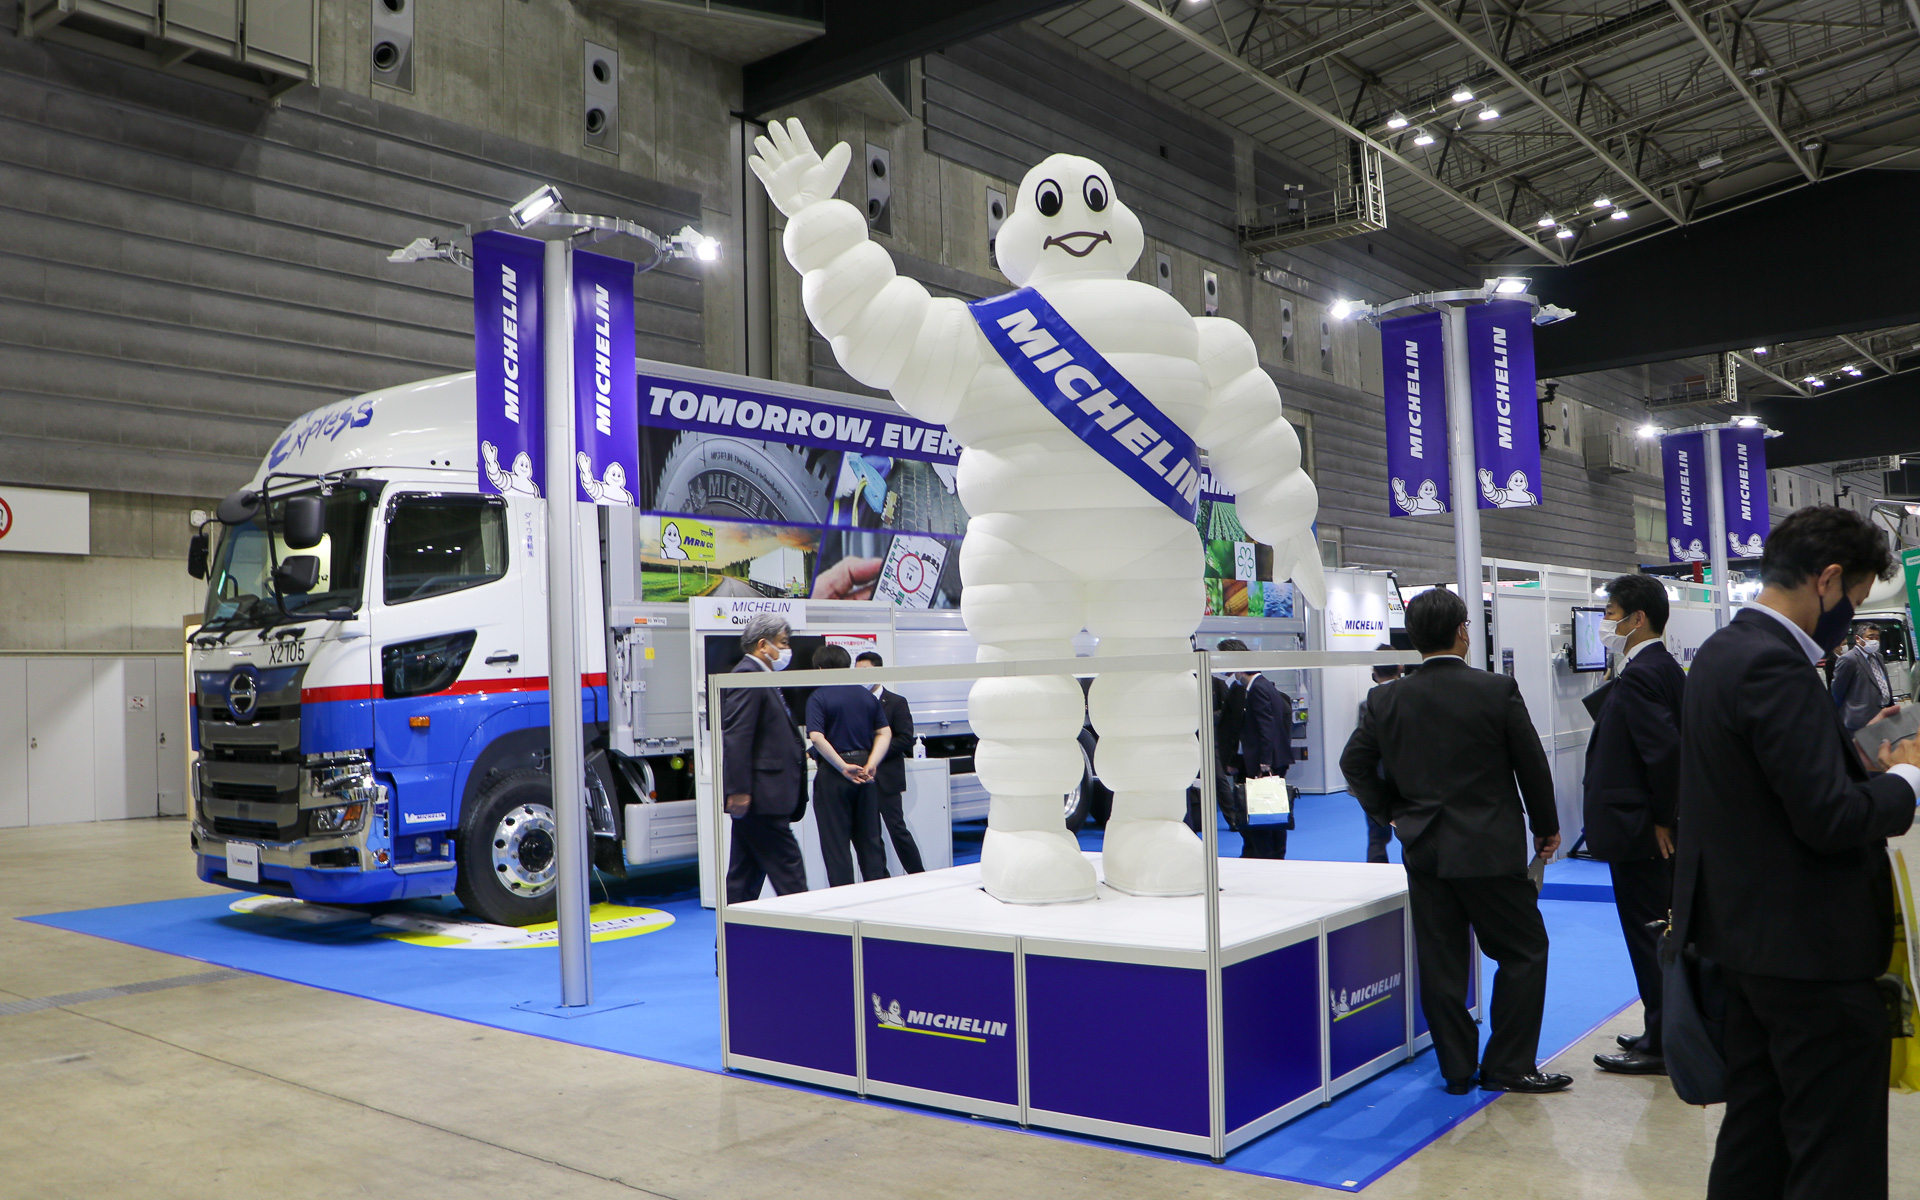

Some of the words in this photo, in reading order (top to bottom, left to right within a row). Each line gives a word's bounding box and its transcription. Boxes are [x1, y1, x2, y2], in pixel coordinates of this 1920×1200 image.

[501, 263, 520, 424] MICHELIN
[595, 283, 611, 436] MICHELIN
[649, 386, 876, 448] TOMORROW,
[996, 308, 1200, 506] MICHELIN
[1405, 340, 1424, 460] MICHELIN
[1492, 326, 1513, 450] MICHELIN
[268, 399, 374, 471] Express
[1678, 449, 1693, 527] MICHELIN
[1737, 443, 1752, 521] MICHELIN
[683, 535, 706, 548] MRN
[731, 601, 791, 613] MICHELIN
[1344, 620, 1383, 630] MICHELIN
[269, 641, 305, 665] X2105
[907, 1010, 1008, 1037] MICHELIN
[1350, 972, 1401, 1006] MICHELIN
